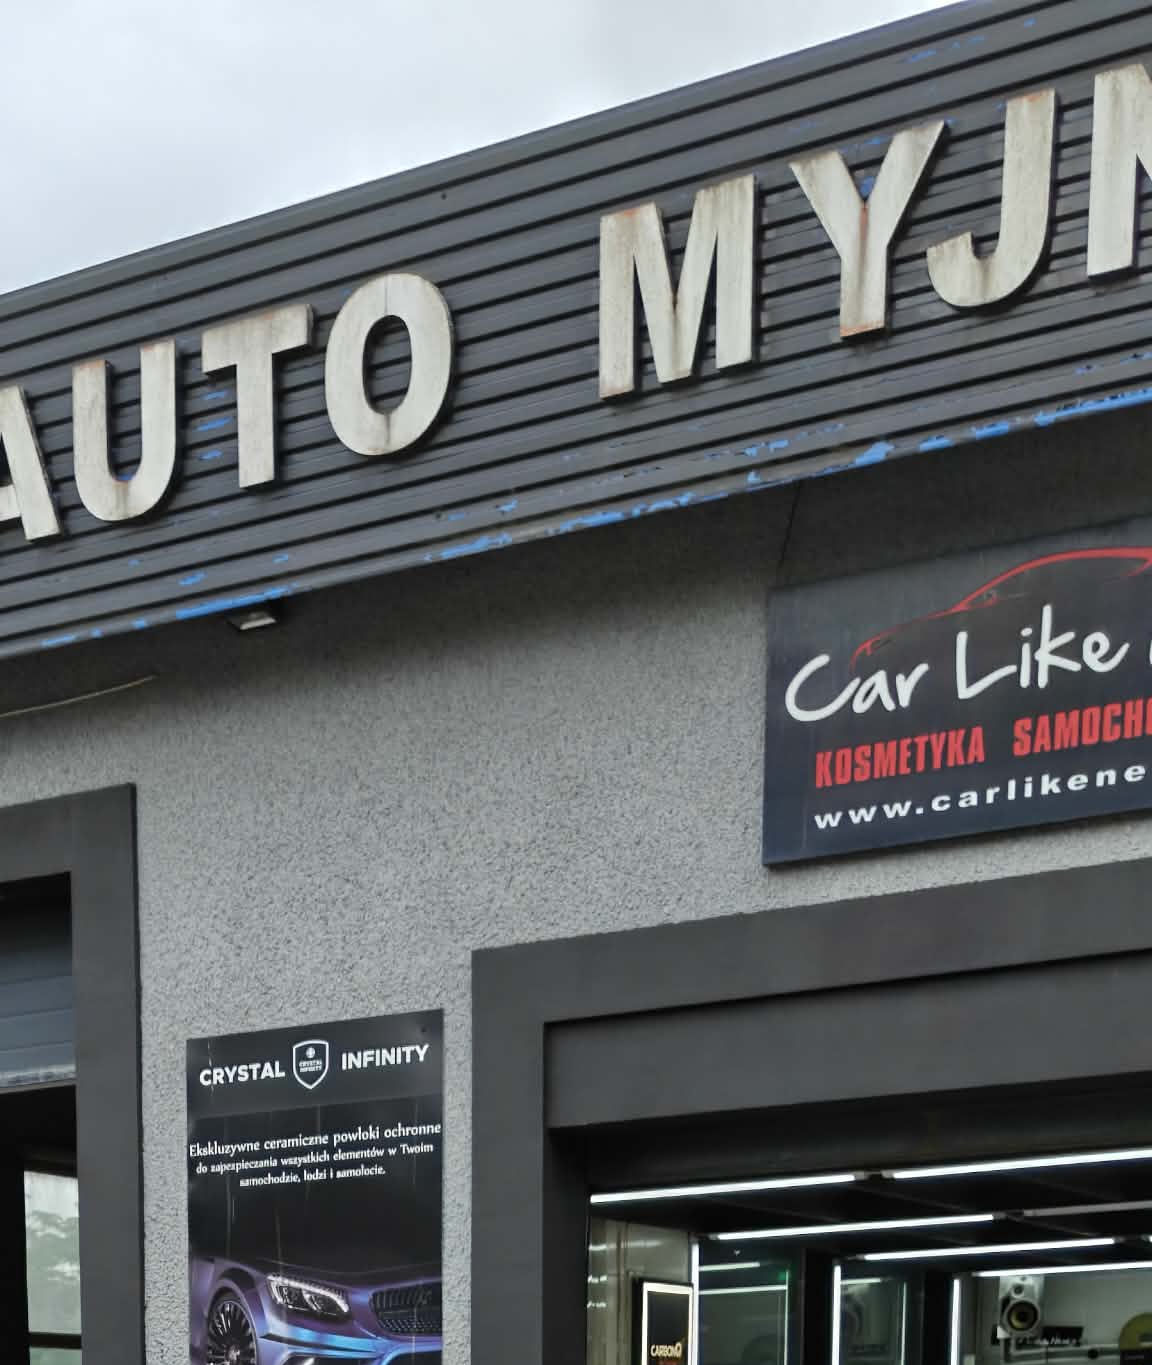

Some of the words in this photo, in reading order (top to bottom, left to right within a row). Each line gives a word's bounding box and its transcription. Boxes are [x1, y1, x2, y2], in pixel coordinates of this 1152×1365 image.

[785, 654, 929, 722] Car
[956, 604, 1130, 699] Like
[815, 726, 985, 788] KOSMETYKA
[199, 1061, 286, 1086] CRYSTAL
[342, 1044, 430, 1071] INFINITY
[189, 1141, 260, 1157] Ekskluzywne
[264, 1133, 328, 1150] ceramiczne
[384, 1122, 441, 1138] ochronne
[196, 1162, 208, 1174] do
[280, 1150, 330, 1167] wszystkich
[333, 1147, 384, 1161] elementów
[388, 1147, 397, 1156] w
[400, 1142, 434, 1155] Twoim
